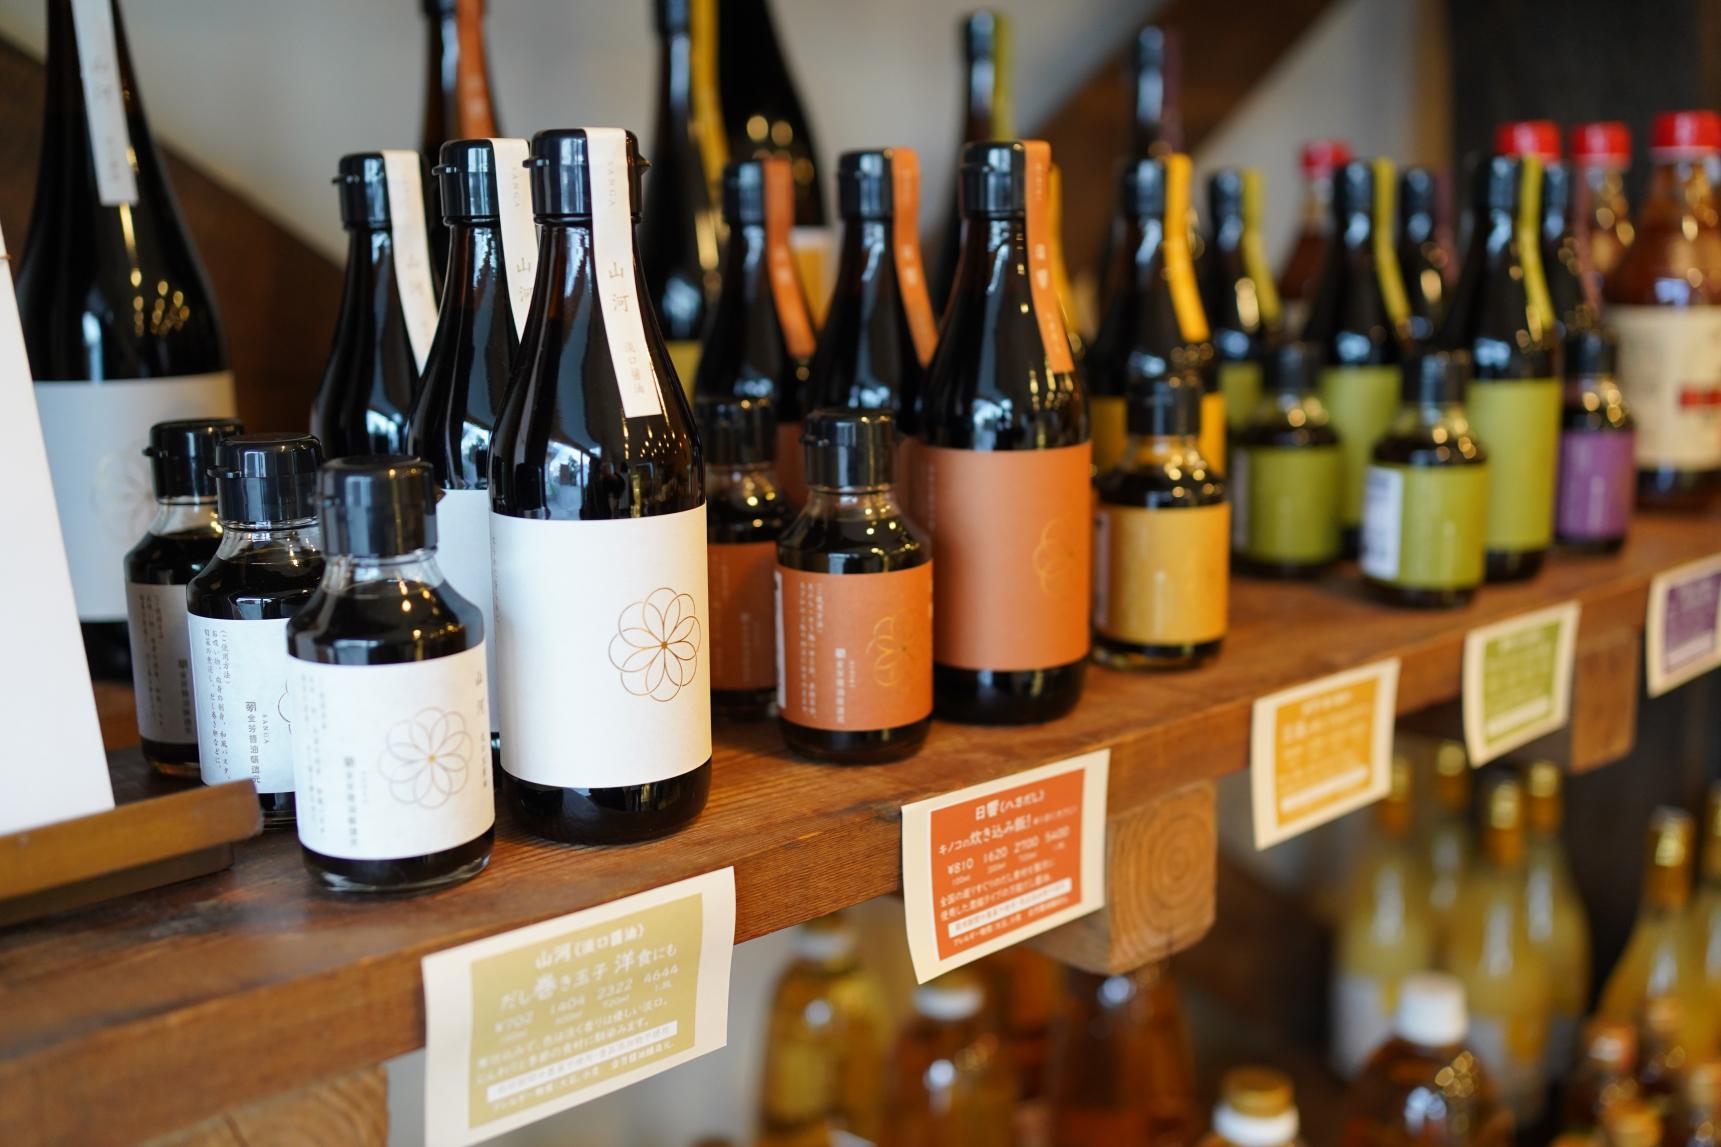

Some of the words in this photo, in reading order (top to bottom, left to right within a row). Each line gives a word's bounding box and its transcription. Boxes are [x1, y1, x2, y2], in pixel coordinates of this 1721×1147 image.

[609, 262, 629, 312] 山河
[947, 858, 974, 875] ¥810
[983, 846, 1008, 864] 1620
